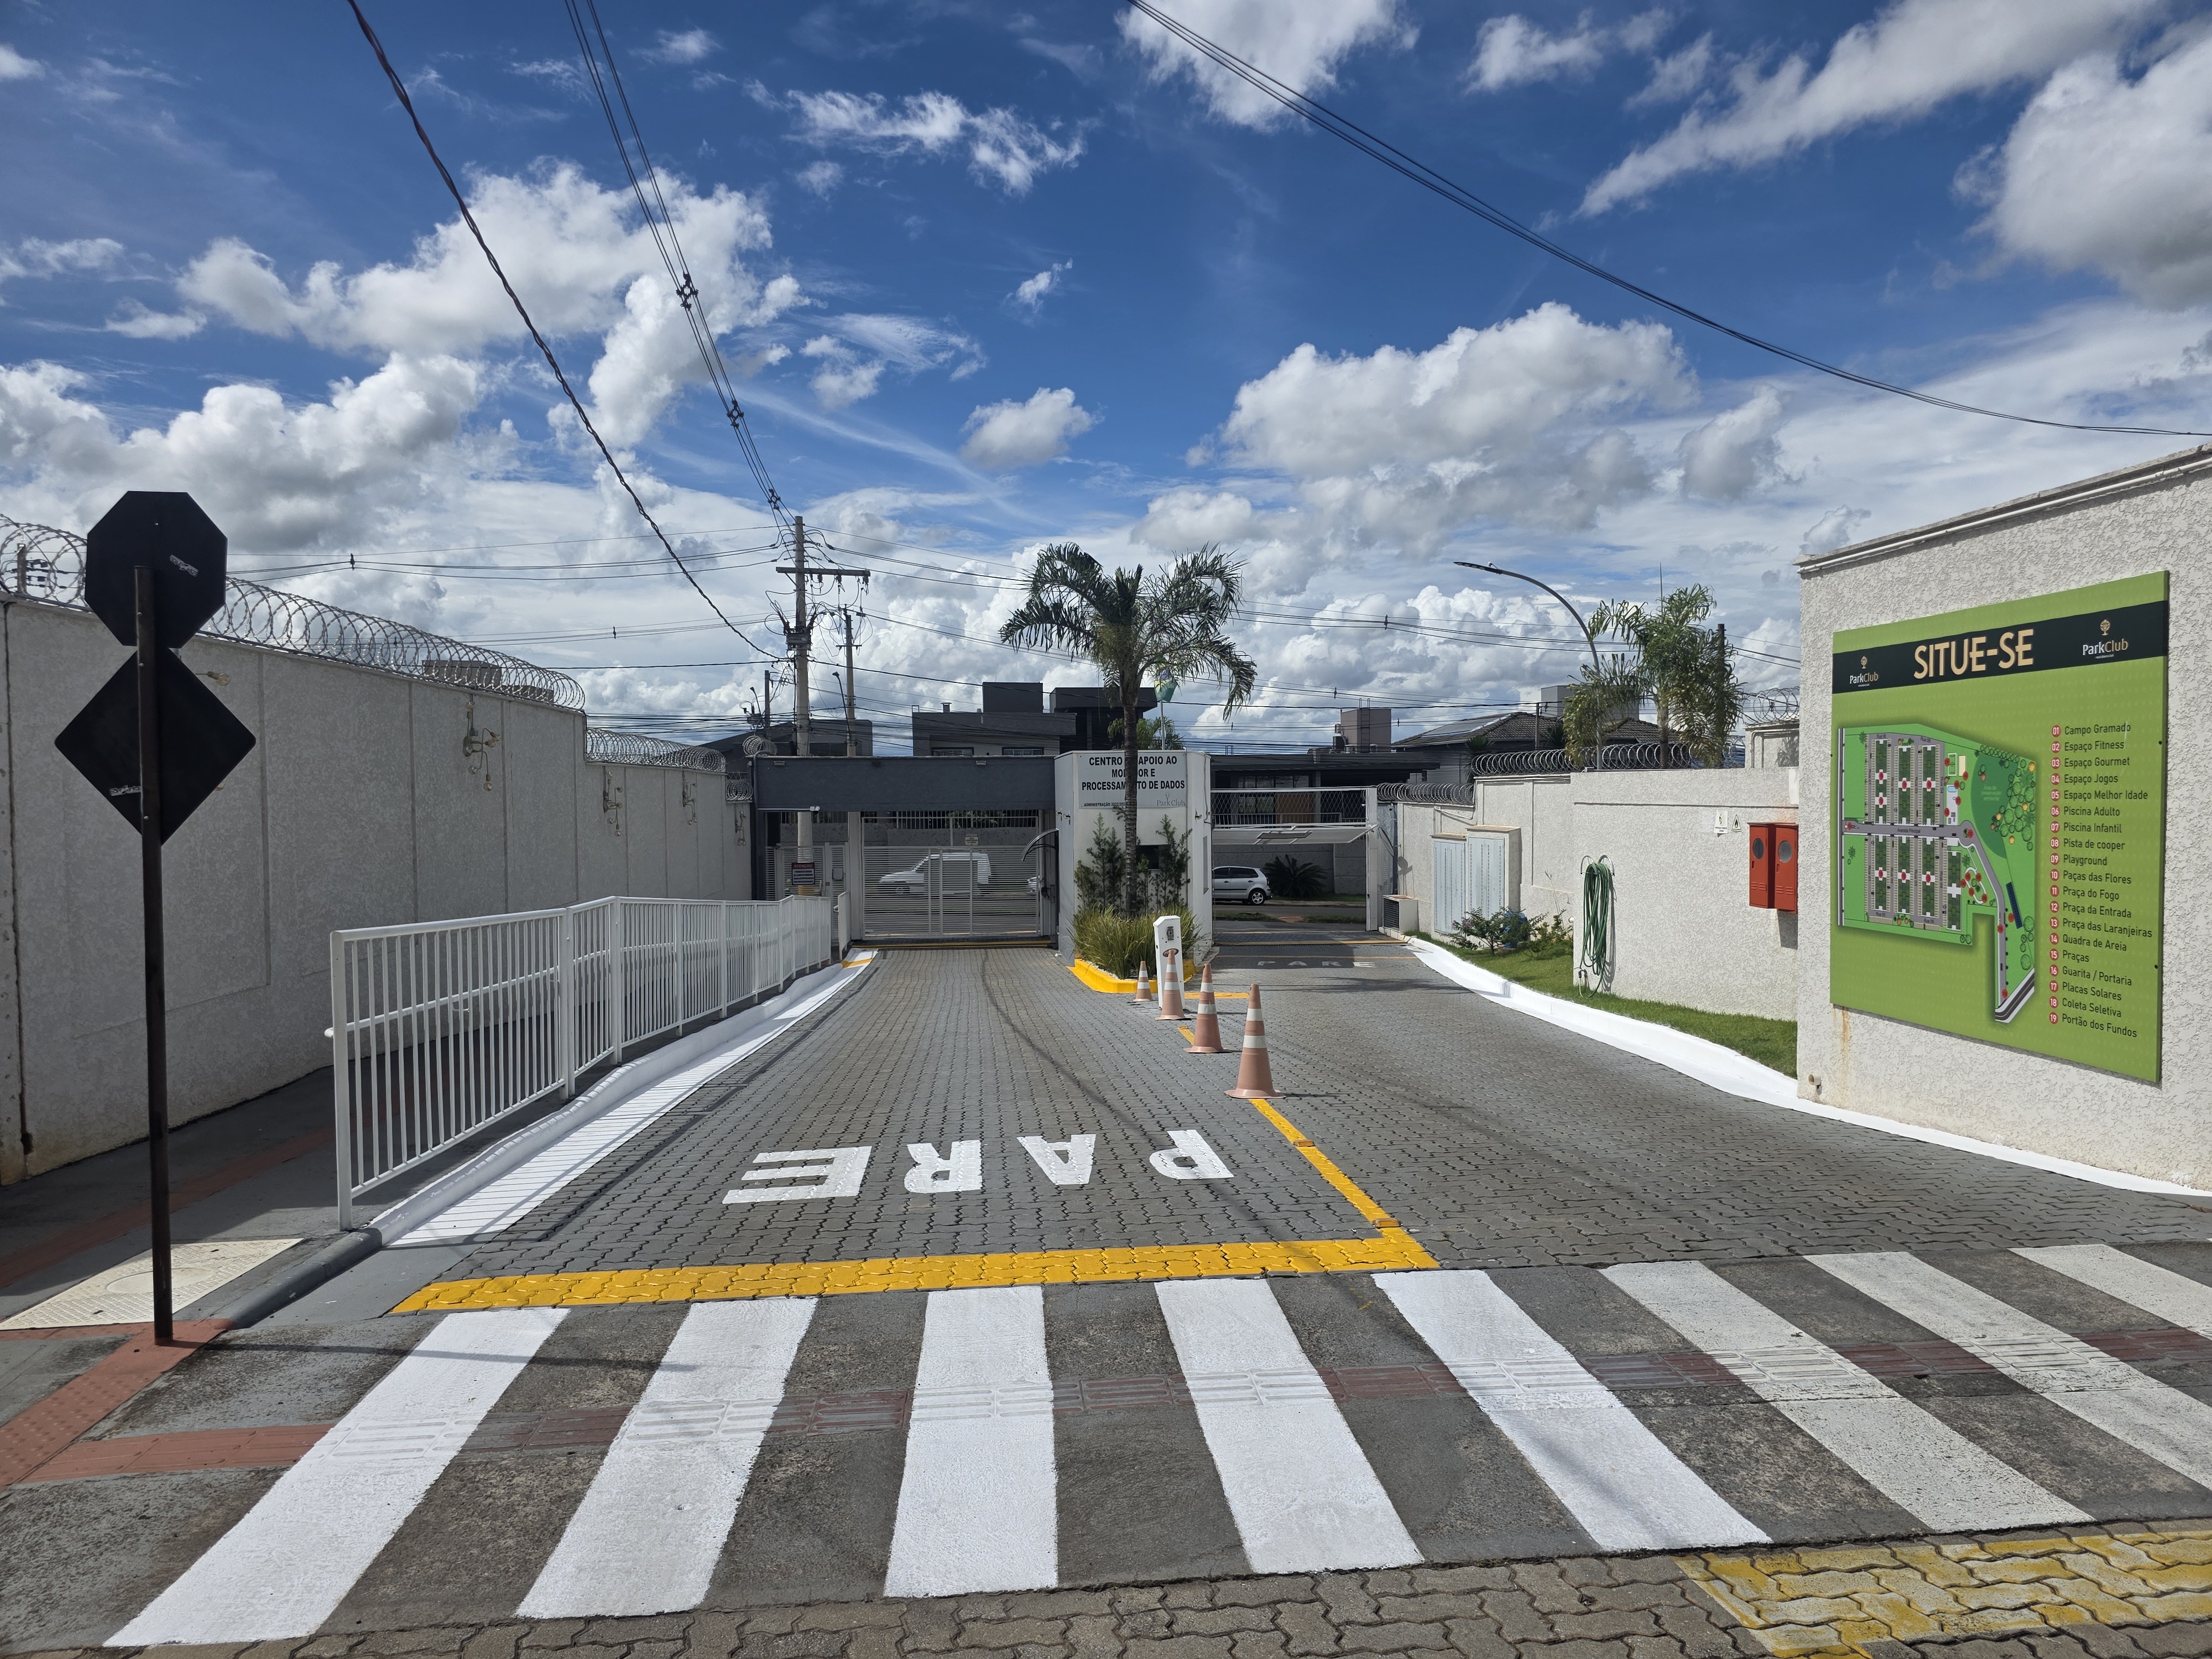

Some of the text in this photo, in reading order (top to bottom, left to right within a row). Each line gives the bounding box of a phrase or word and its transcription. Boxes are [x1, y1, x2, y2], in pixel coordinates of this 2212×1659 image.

[2083, 638, 2128, 656] ParkClub
[1913, 629, 2034, 679] SITUE-SE
[1849, 671, 1879, 684] ParkClub
[2065, 726, 2091, 736] Campo
[2094, 723, 2131, 733] Gramado
[2065, 742, 2091, 753] Espaço
[2095, 740, 2124, 749] Fitness
[1089, 756, 1177, 766] CENTRO APOIO AO
[2064, 758, 2091, 769] Espaço
[2095, 757, 2130, 766] Gourmet
[1151, 769, 1155, 777] E
[2064, 774, 2091, 785] Espaço
[2094, 774, 2118, 785] Jogos
[1082, 780, 1185, 790] PROCESSAMTO DE DADOS
[2064, 790, 2091, 801] Espaço
[2094, 790, 2122, 799] Melhor
[2126, 790, 2148, 799] Idade
[2064, 806, 2091, 815] Piscina
[2094, 807, 2120, 816] Adulto
[2064, 822, 2091, 832] Piscina
[2094, 823, 2121, 833] Infantil
[2064, 838, 2082, 847] Pista
[2085, 839, 2094, 848] de
[2097, 842, 2125, 852] cooper
[2064, 854, 2107, 866] Playground
[2064, 870, 2086, 882] Paças
[2089, 872, 2102, 881] das
[2106, 873, 2131, 884] Flores
[2063, 886, 2085, 898] Praça
[2088, 889, 2096, 898] do
[2100, 889, 2119, 901] Fogo
[2063, 902, 2084, 915] Praça
[2088, 905, 2096, 914] da
[2100, 906, 2131, 918] Entrada
[2063, 918, 2084, 931] Praça
[2088, 921, 2101, 931] das
[2104, 923, 2152, 937] Laranjeiras
[2063, 934, 2090, 946] Quadra
[2093, 938, 2102, 947] de
[2105, 940, 2126, 951] Areia
[2063, 950, 2089, 963] Praças
[2063, 966, 2090, 978] Guarita
[2093, 970, 2097, 981] /
[2099, 972, 2131, 985] Portaria
[2063, 982, 2088, 994] Placas
[2090, 987, 2121, 1000] Solares
[2063, 998, 2086, 1010] Coleta
[2089, 1003, 2121, 1017] Seletiva
[2063, 1014, 2087, 1026] Portão
[2090, 1020, 2104, 1030] dos
[2107, 1023, 2137, 1037] Fundos
[722, 1129, 1234, 1203] PARE
